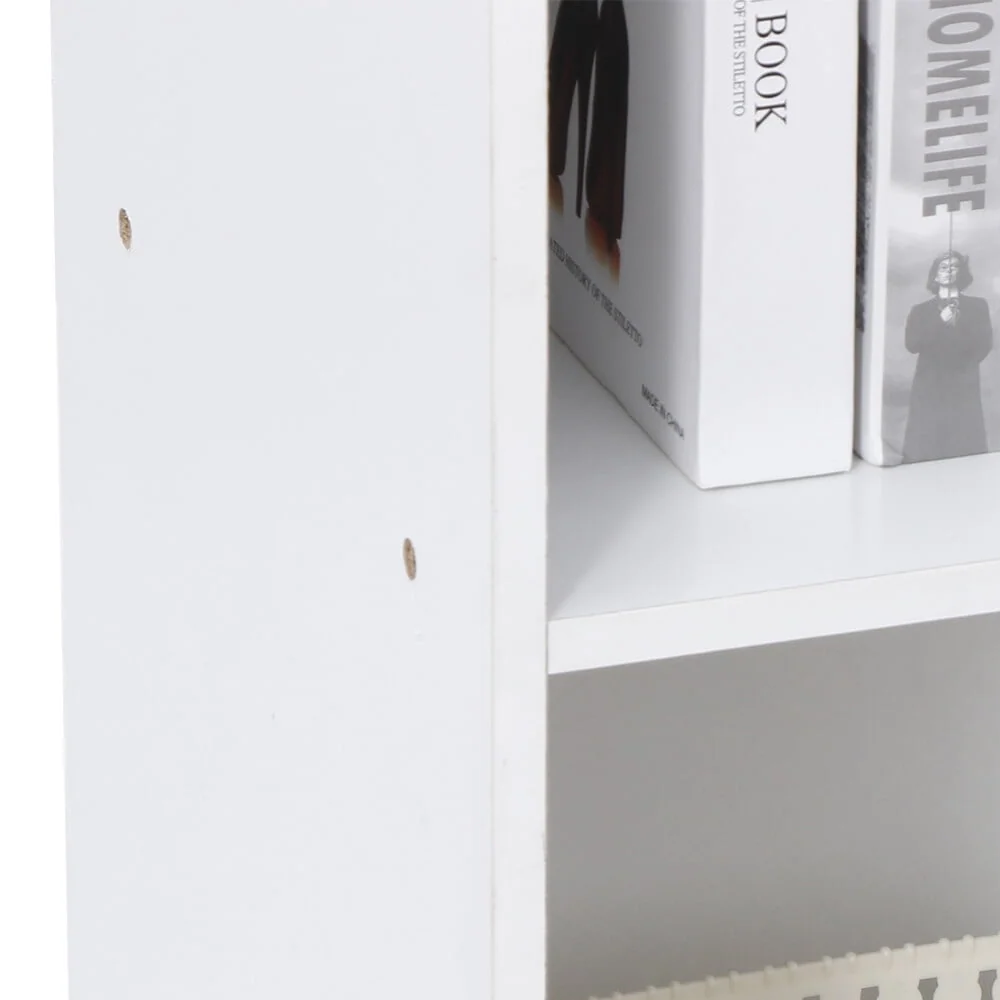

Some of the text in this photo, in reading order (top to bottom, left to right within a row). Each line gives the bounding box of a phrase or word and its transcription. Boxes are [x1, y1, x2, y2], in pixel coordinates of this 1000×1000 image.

[733, 20, 746, 49] THE
[733, 50, 746, 117] STILETTO
[754, 10, 788, 132] BOOK
